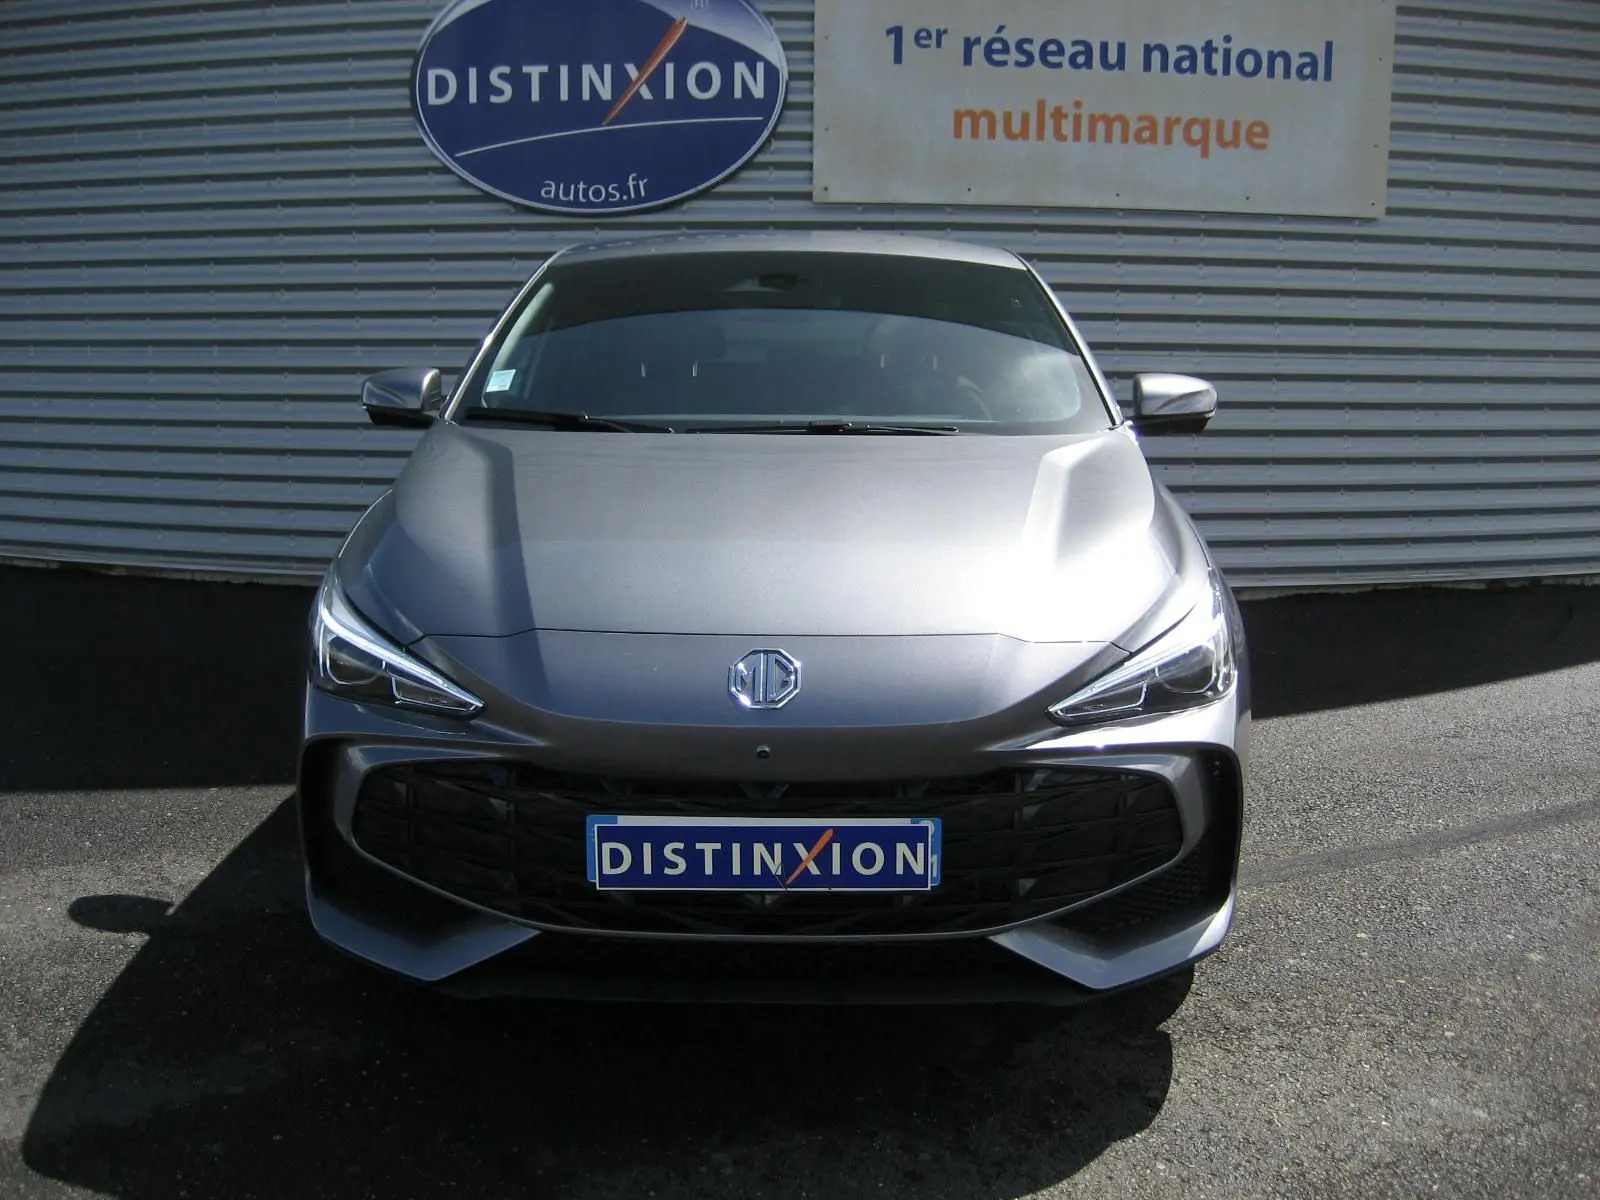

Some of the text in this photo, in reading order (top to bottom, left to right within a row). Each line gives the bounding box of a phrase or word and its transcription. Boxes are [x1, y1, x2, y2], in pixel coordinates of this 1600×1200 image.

[962, 24, 1127, 72] réseau
[1142, 34, 1334, 82] national
[426, 60, 766, 106] DISTINXION
[951, 99, 1271, 160] multimarque
[540, 172, 650, 203] autos.fr
[731, 650, 798, 706] MG
[601, 841, 926, 877] DISTINXION
